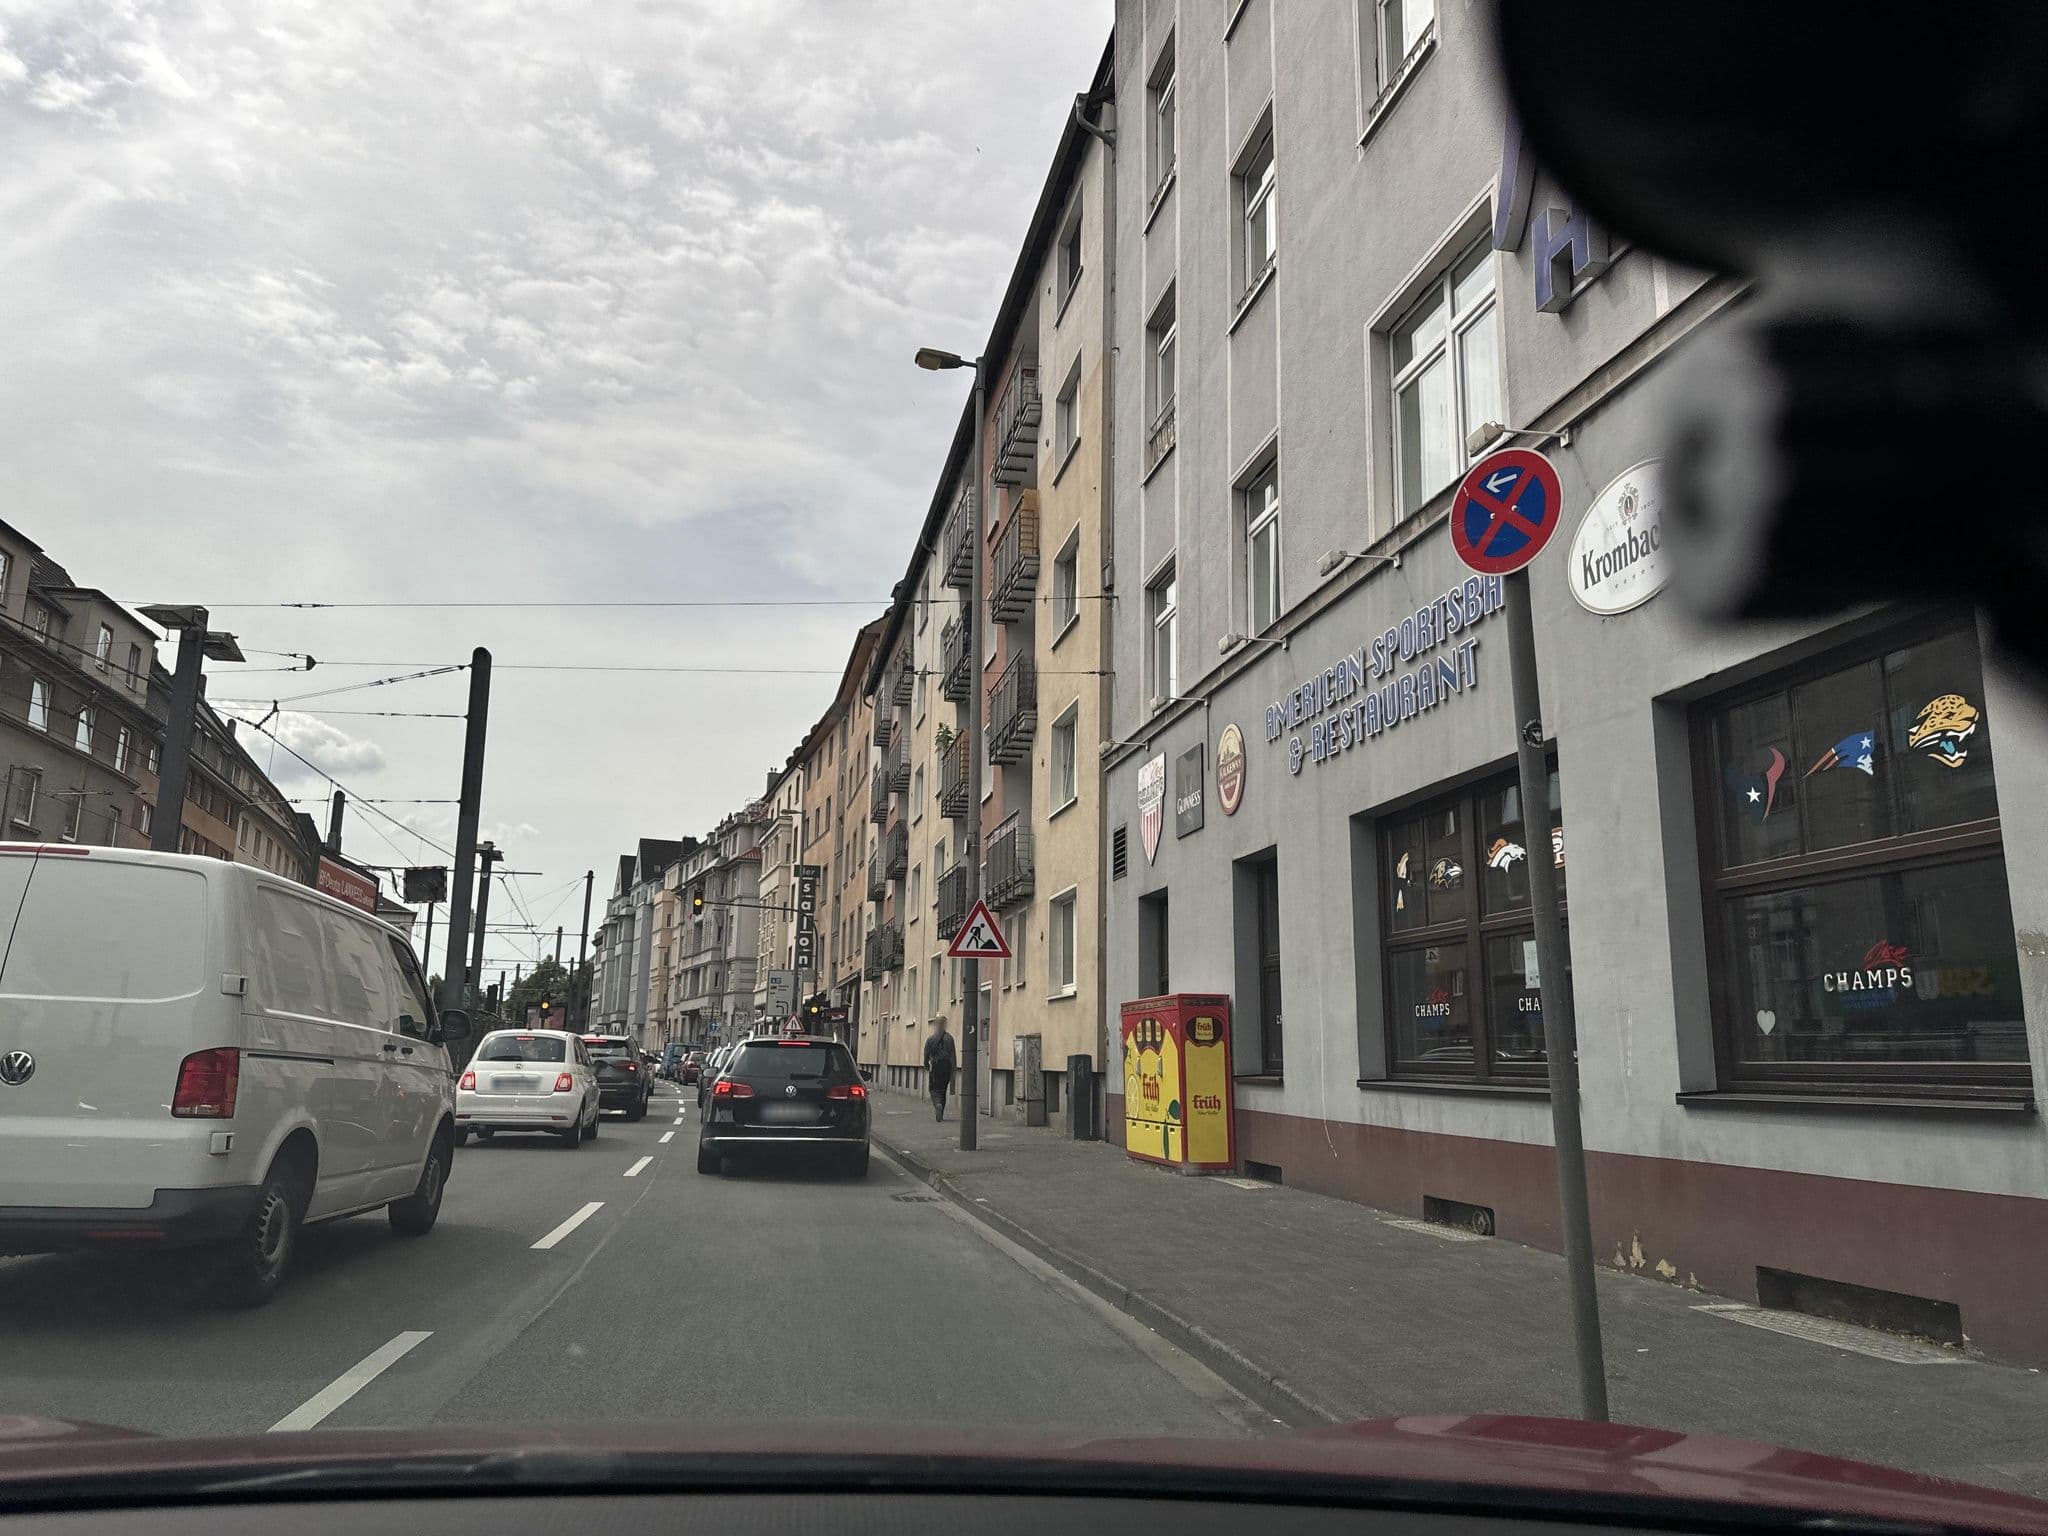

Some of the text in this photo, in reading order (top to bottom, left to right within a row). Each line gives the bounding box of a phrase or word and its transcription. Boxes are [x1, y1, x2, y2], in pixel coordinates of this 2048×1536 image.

[1582, 525, 1660, 590] Krombac
[1264, 574, 1505, 743] AMERICAN SPORTSBA
[1288, 636, 1480, 775] & RESTAURANT
[1177, 789, 1201, 815] GUINNESS
[799, 882, 812, 966] salon
[1823, 967, 1913, 992] CHAMPS
[1415, 1003, 1450, 1017] CHAMPS
[1518, 998, 1540, 1012] CHA
